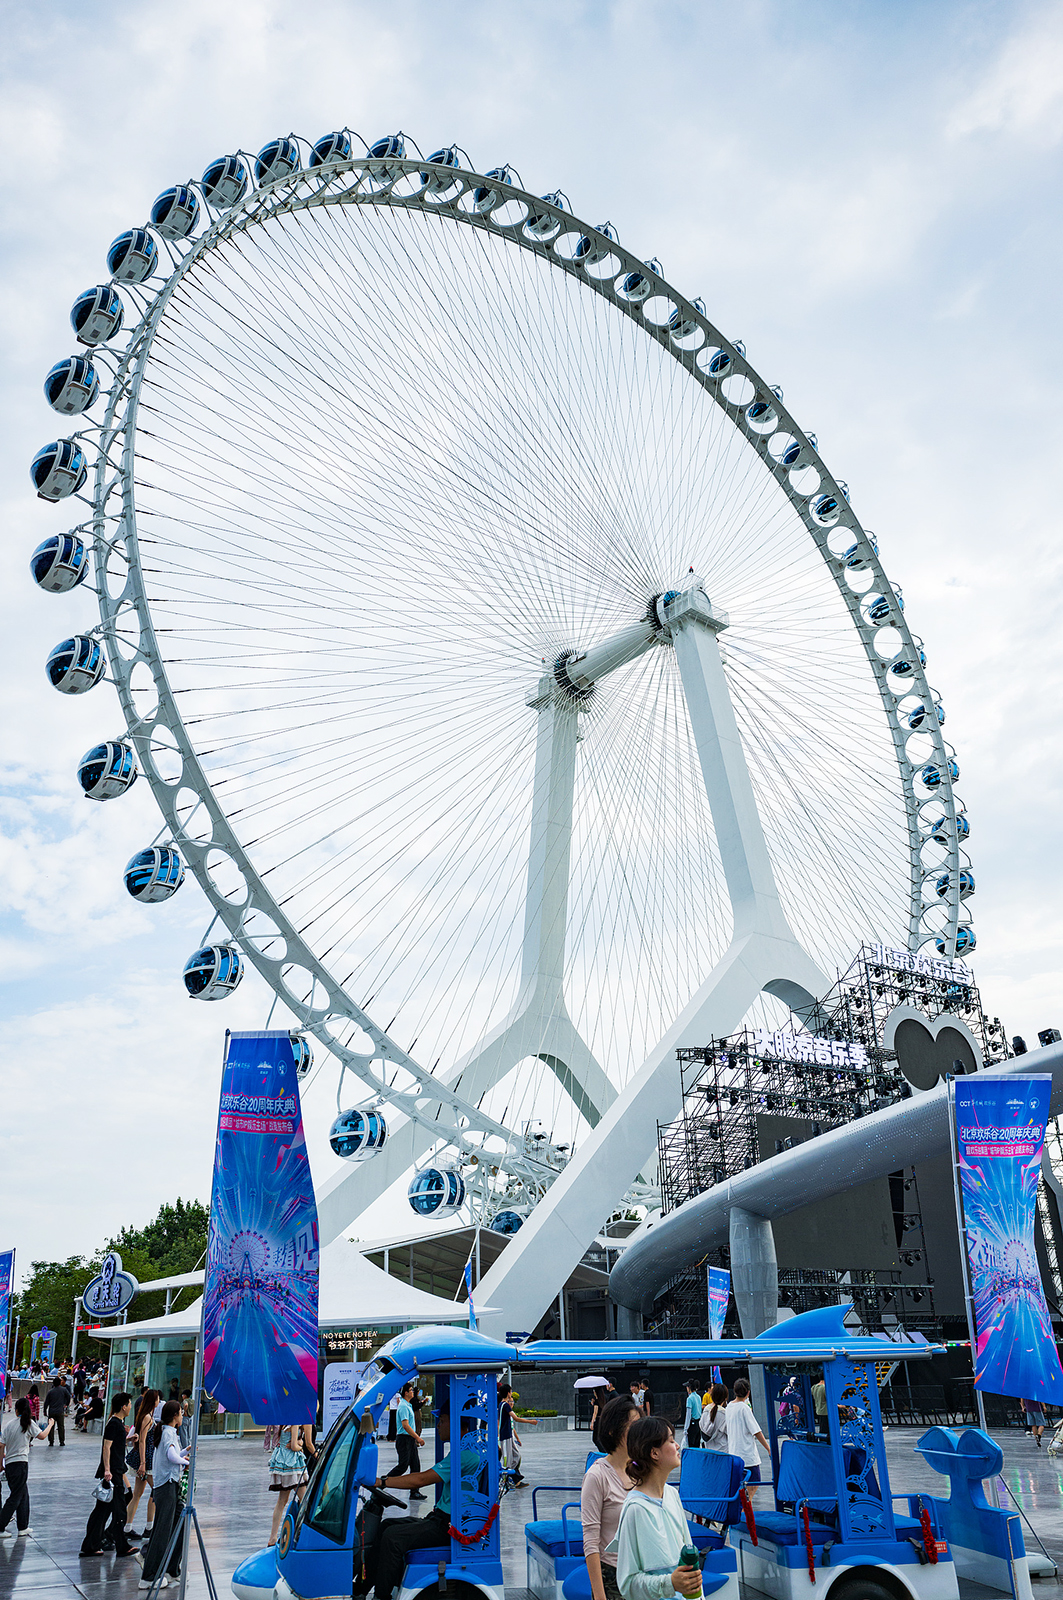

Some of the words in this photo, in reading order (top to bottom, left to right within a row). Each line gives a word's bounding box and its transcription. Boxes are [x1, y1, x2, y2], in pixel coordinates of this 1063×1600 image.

[869, 942, 972, 986] 北京欢乐谷
[754, 1028, 868, 1070] 大眼京音乐季
[959, 1100, 971, 1108] OCT
[962, 1126, 1041, 1141] 北京欢乐谷20周年庆典
[334, 1331, 351, 1339] YEYE
[328, 1339, 373, 1351] 爷爷不泡茶
